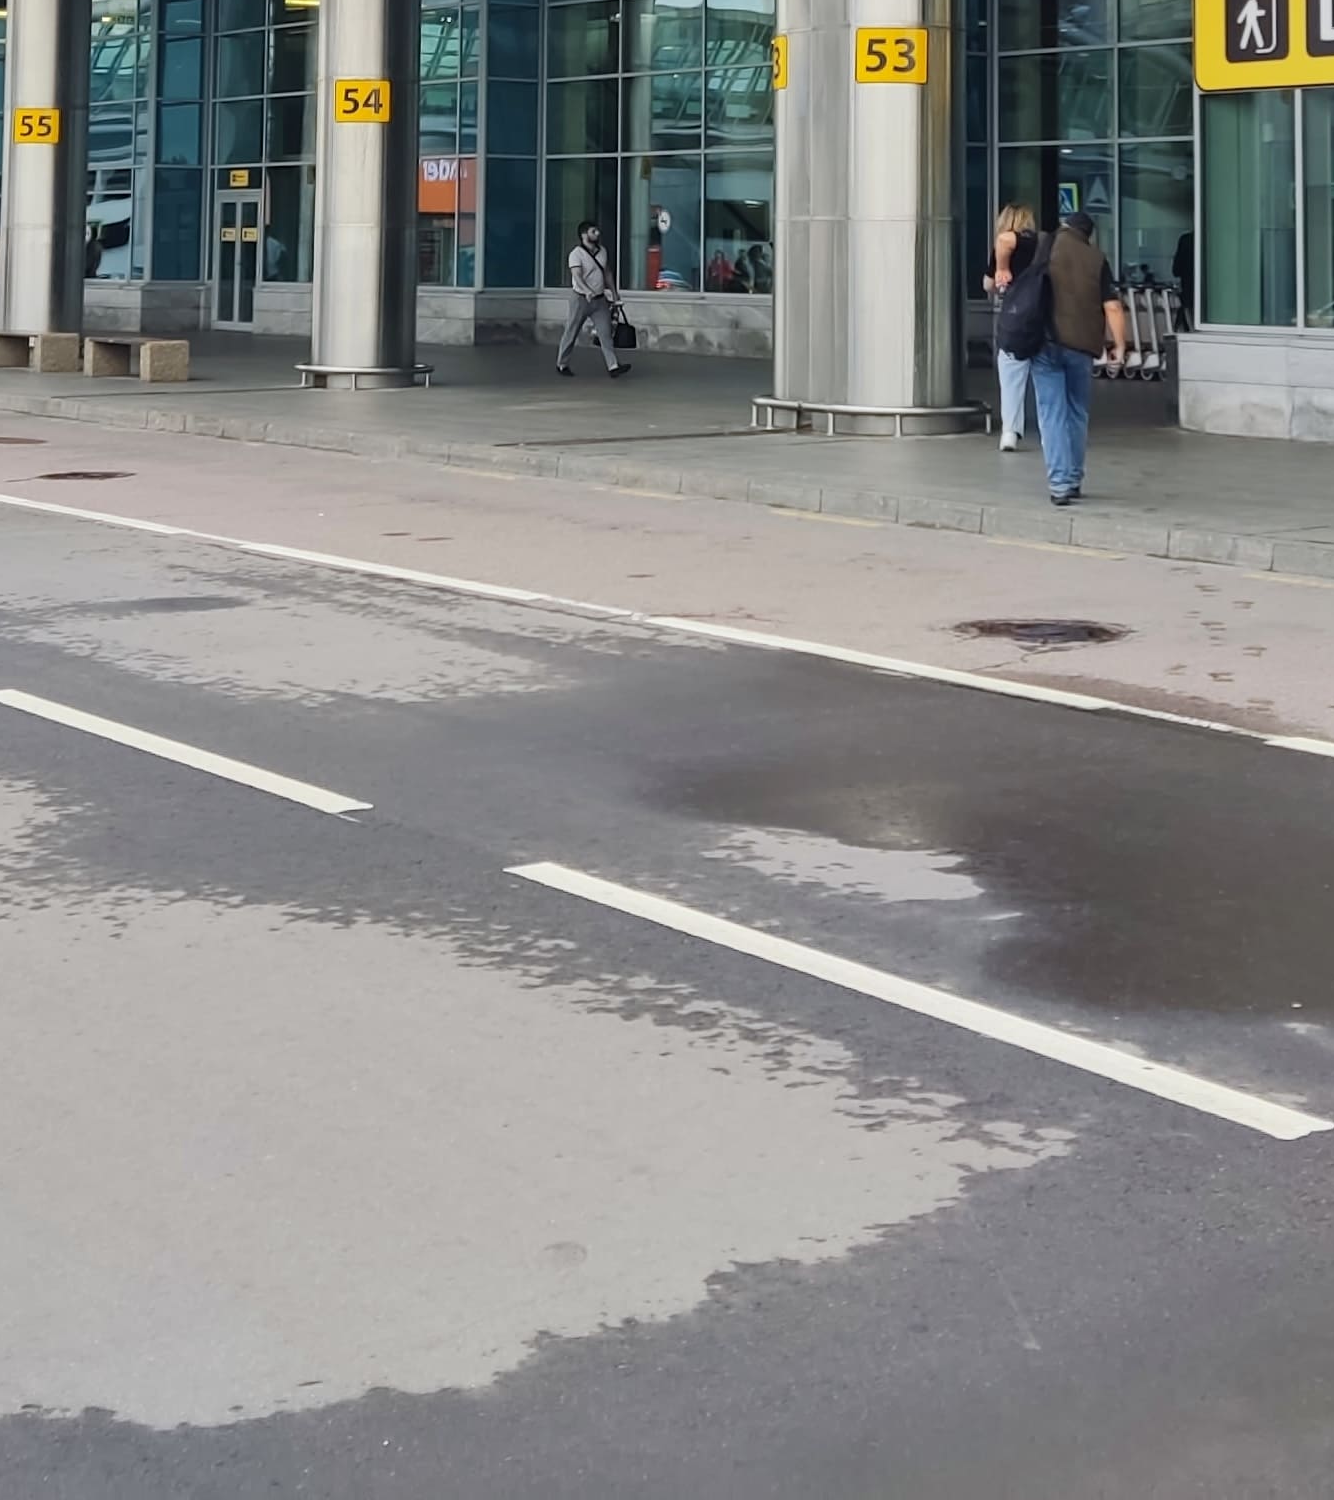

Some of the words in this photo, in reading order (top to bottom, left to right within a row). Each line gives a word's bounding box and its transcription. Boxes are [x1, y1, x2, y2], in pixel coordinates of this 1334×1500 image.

[865, 38, 917, 73] 53
[341, 88, 384, 115] 54
[19, 115, 53, 137] 55
